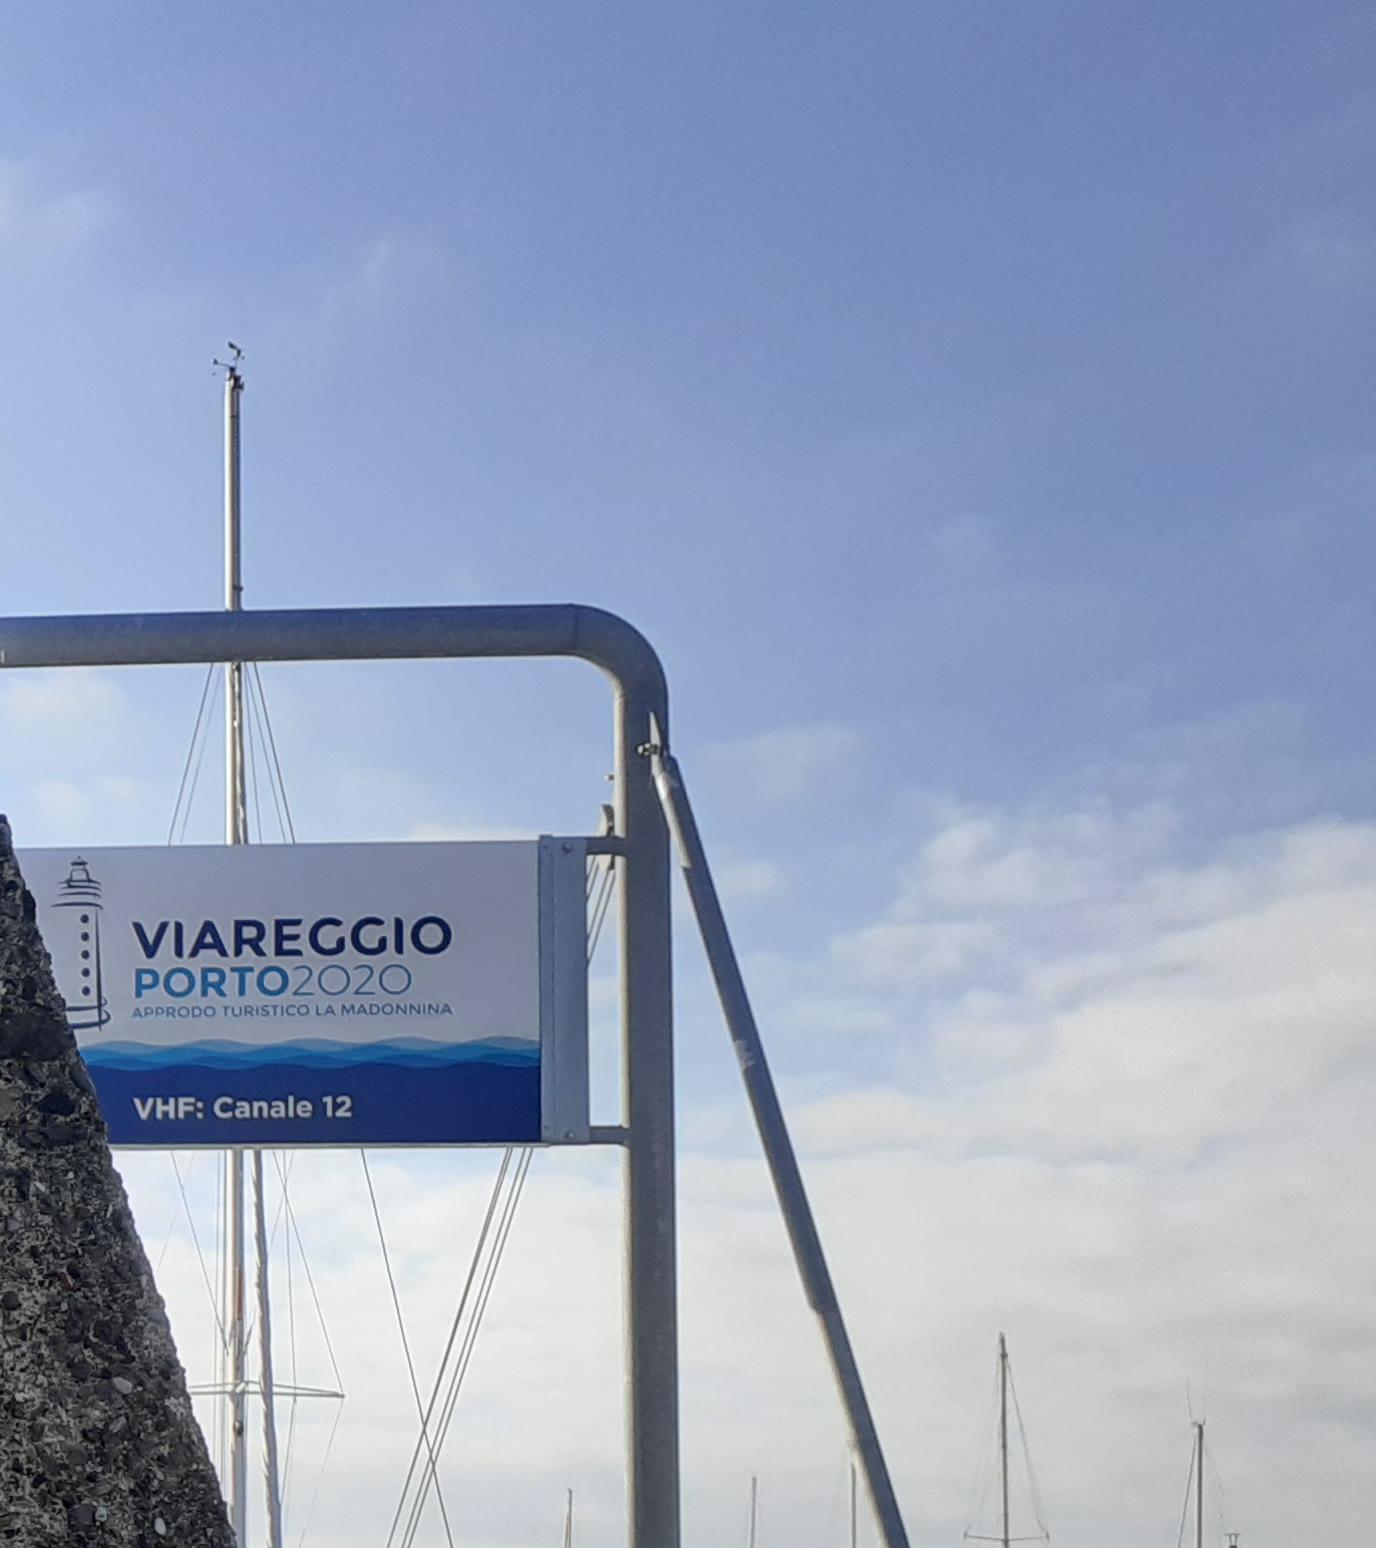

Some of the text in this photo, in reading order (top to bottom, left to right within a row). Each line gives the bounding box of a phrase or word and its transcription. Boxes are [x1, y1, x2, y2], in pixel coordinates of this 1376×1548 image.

[132, 915, 452, 959] VIAREGGIO
[131, 1002, 453, 1019] APPRODO TURISTICO LA MADONNINA
[133, 1095, 352, 1121] VHF: Canale 12
